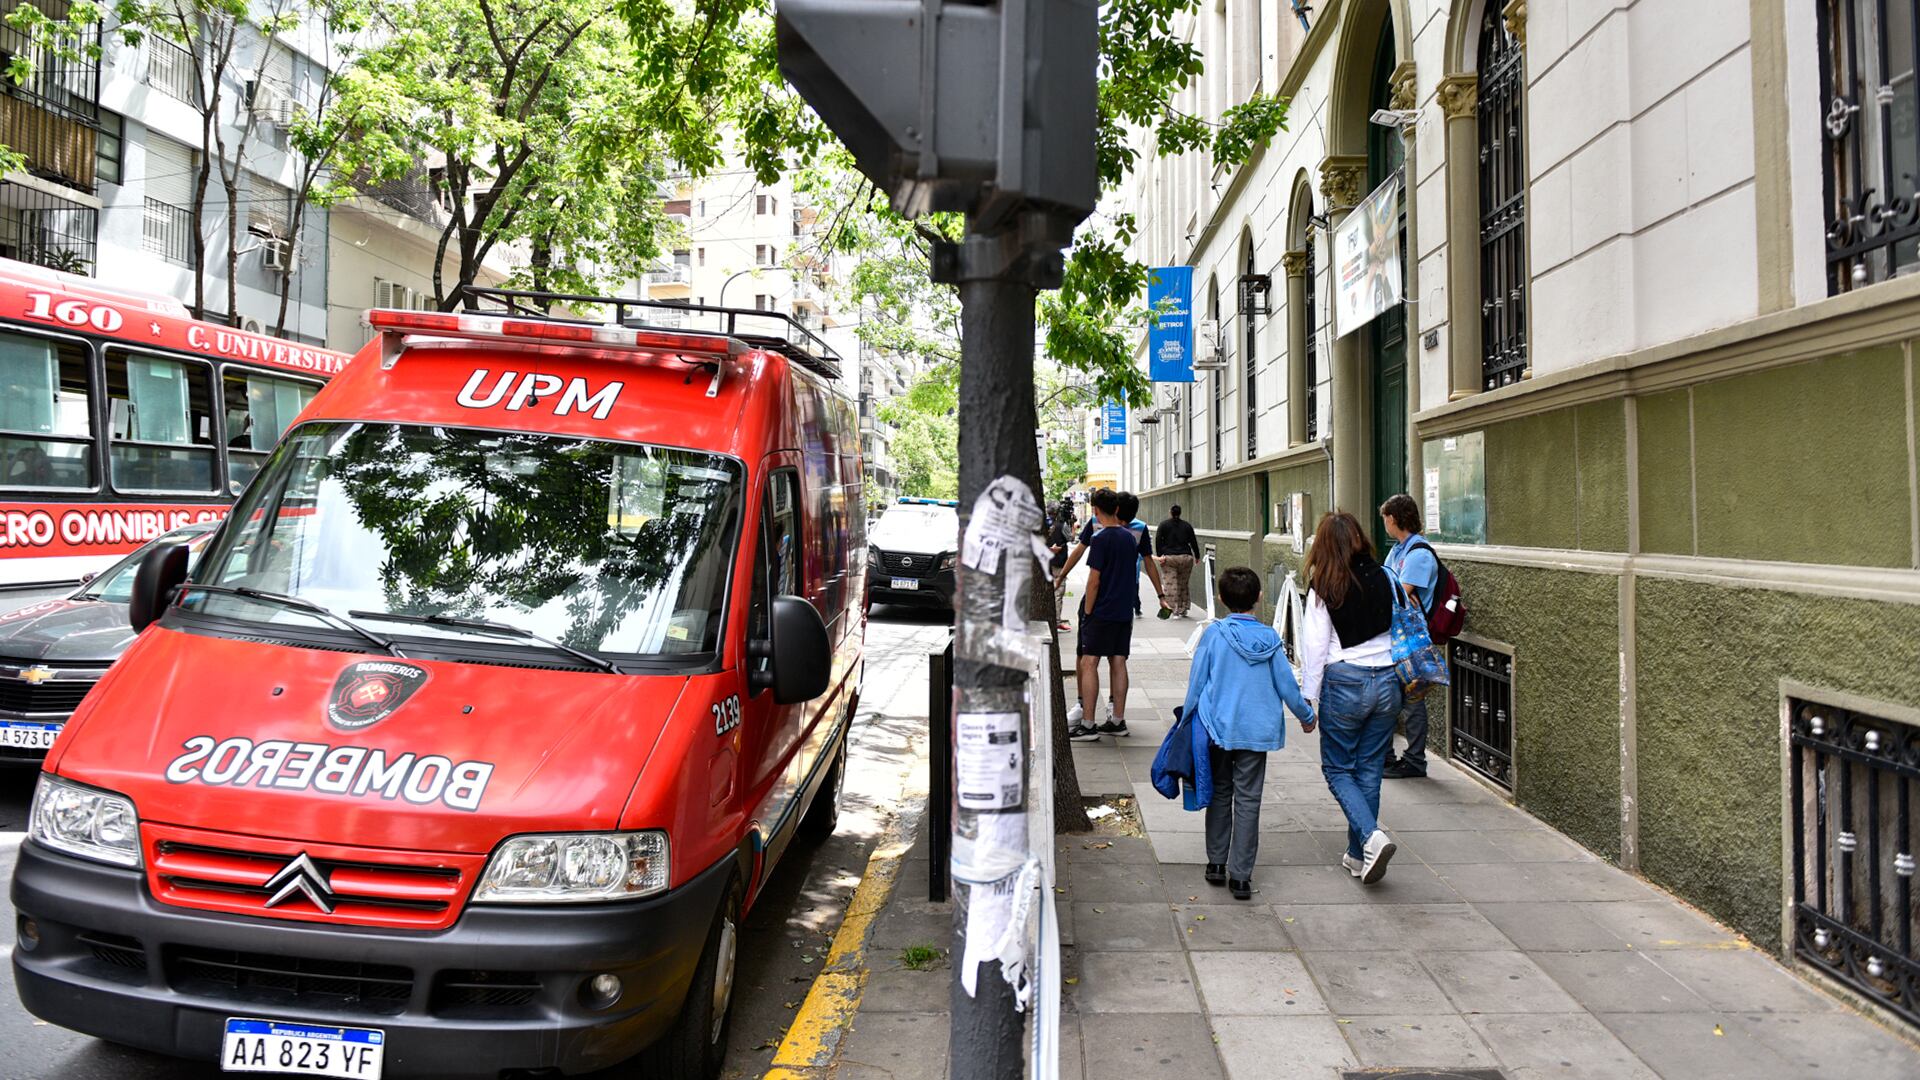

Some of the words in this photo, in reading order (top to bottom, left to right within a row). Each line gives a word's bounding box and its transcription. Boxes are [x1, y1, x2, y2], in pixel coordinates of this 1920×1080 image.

[24, 292, 124, 332] 160
[187, 325, 211, 351] C.
[456, 368, 625, 420] UPM
[356, 662, 422, 679] BOMBEROS
[712, 694, 741, 736] 2139
[14, 730, 38, 746] 573
[994, 873, 1020, 896] MA
[231, 1037, 266, 1066] AA
[279, 1039, 330, 1069] 823
[342, 1044, 374, 1074] YF
